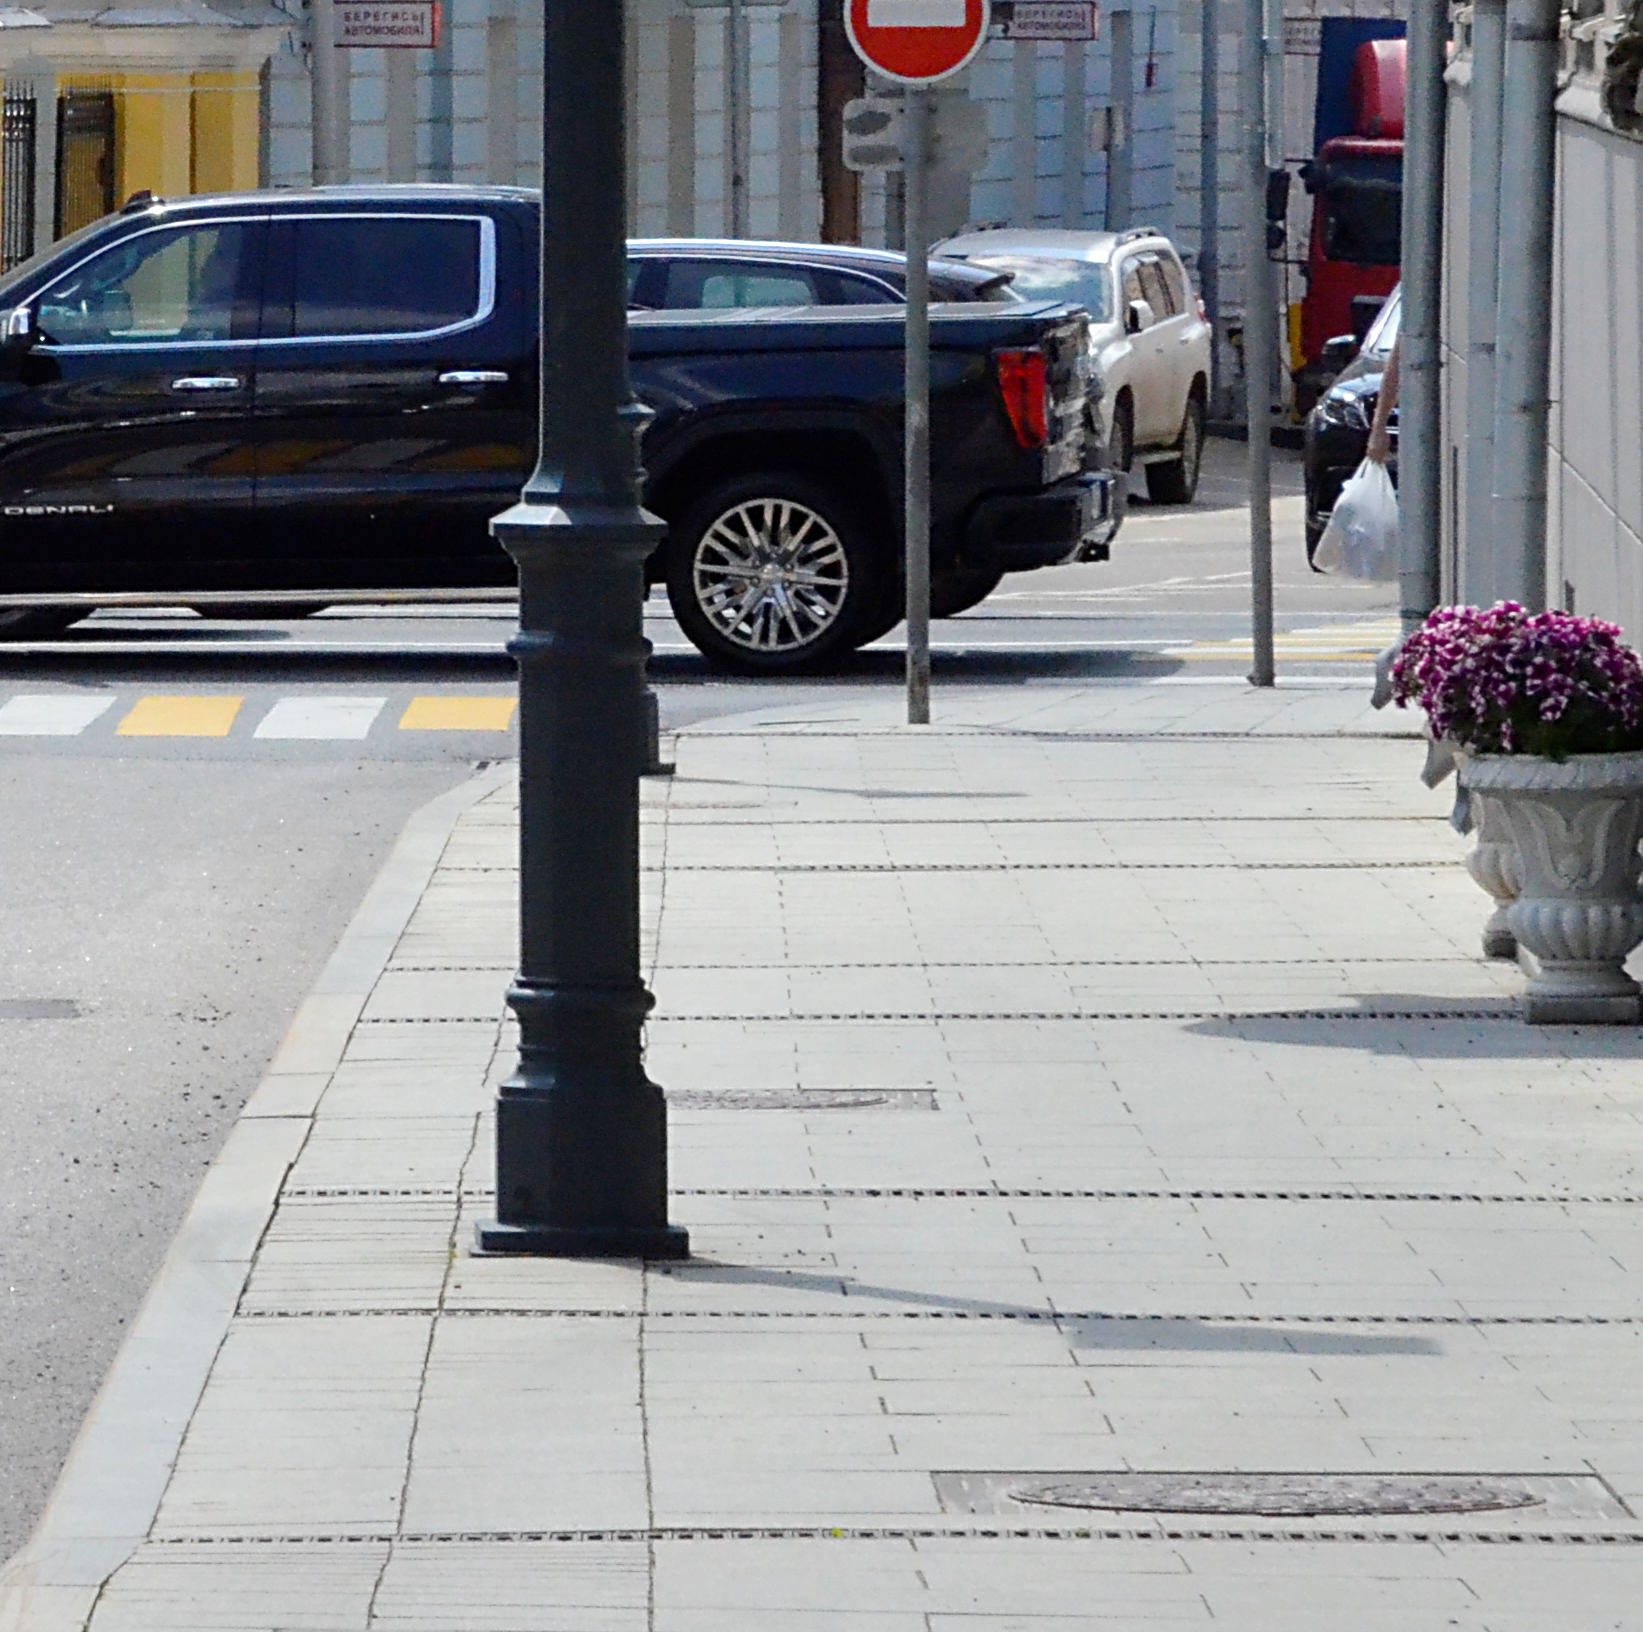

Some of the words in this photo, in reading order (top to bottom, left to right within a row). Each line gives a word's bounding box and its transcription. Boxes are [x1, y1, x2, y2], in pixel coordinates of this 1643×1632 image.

[344, 11, 419, 22] БЕРЕГИСЬ
[344, 25, 420, 36] АВТОМОБИЛЯ
[4, 504, 114, 516] DENALI
